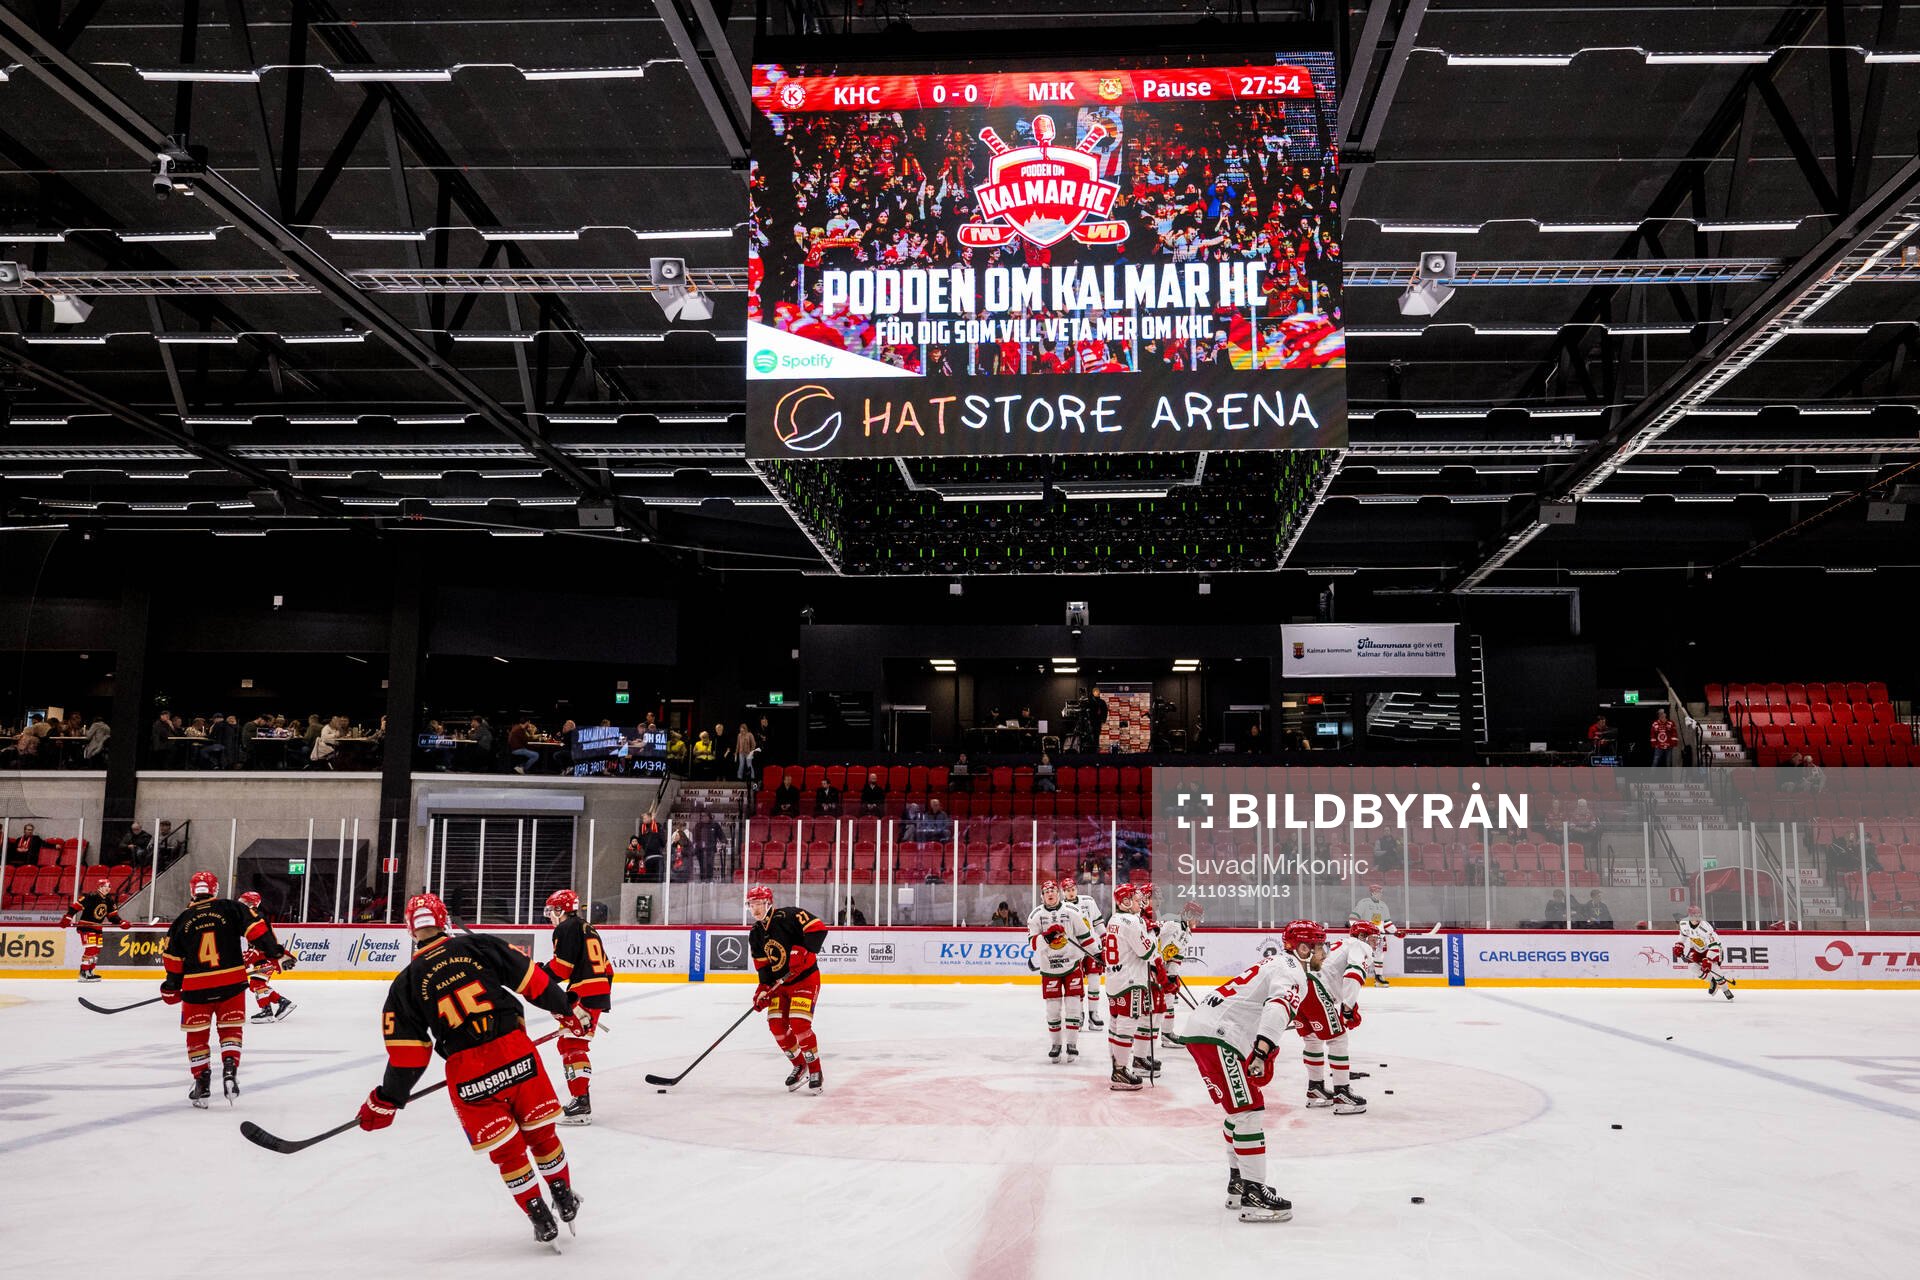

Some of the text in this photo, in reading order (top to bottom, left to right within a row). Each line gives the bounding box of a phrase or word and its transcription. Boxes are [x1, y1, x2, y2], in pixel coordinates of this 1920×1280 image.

[1029, 82, 1075, 100] MIK
[1143, 80, 1211, 97] Pause
[1241, 75, 1300, 95] 27:54
[834, 86, 881, 105] KHC
[933, 86, 945, 103] 0
[965, 84, 978, 102] 0
[1021, 164, 1065, 177] PODDEN OM
[980, 179, 1111, 215] KALMAR HC
[822, 261, 1267, 315] PODDEN OM KALMAR HC
[876, 314, 1214, 345] FÖR DIG SOM VILL VETA MER OM KHC
[781, 354, 833, 370] Spotify
[863, 390, 1319, 437] HATSTORE ARENA
[1357, 637, 1411, 650] Tillsammans
[198, 931, 220, 968] 4
[293, 938, 330, 950] Svensk
[363, 938, 400, 950] Svensk
[627, 944, 675, 955] ÖLANDS
[694, 932, 702, 972] BAUER
[832, 943, 858, 954] RÖR
[885, 945, 893, 954] &
[940, 943, 973, 958] K-V
[1184, 947, 1205, 957] FIT
[1406, 946, 1440, 955] KIA
[298, 951, 327, 962] Cater
[367, 951, 397, 962] Cater
[586, 938, 606, 973] 9
[658, 959, 675, 968] AB
[1479, 951, 1609, 962] CARLBERGS BYGG
[436, 971, 466, 990] KALMAR
[437, 979, 494, 1029] 15
[459, 1058, 532, 1098] JEANSBOLAGET
